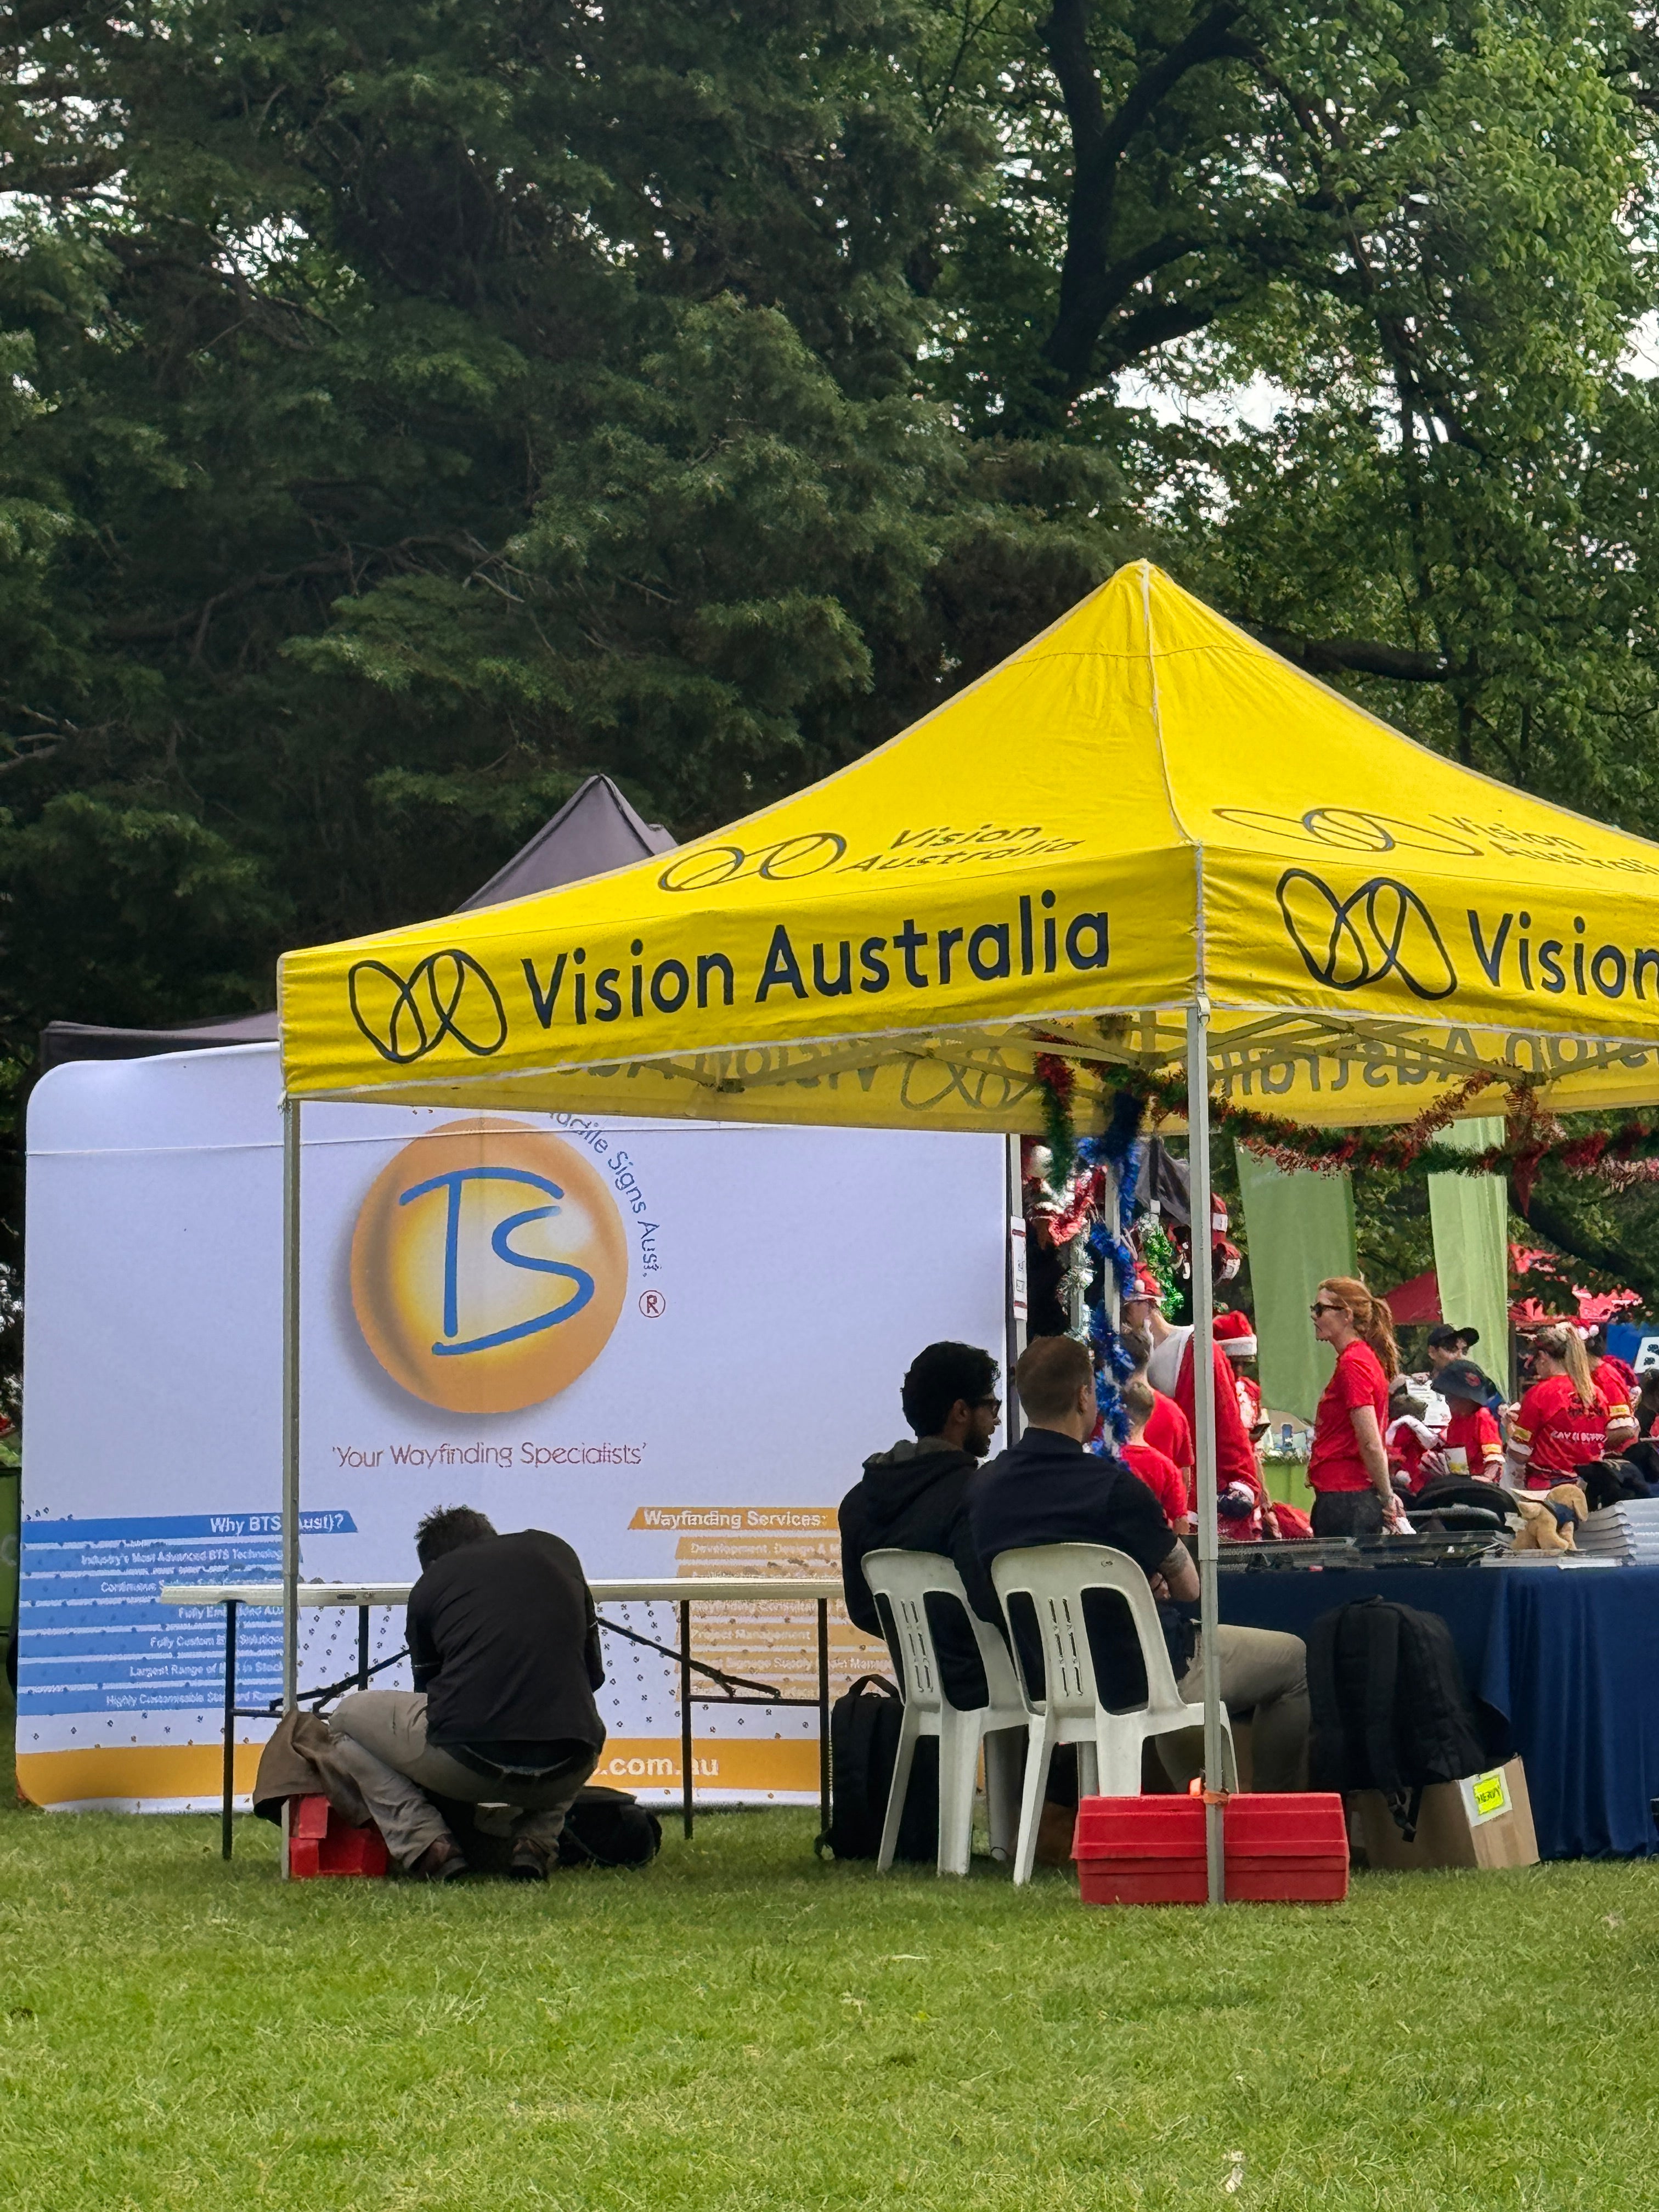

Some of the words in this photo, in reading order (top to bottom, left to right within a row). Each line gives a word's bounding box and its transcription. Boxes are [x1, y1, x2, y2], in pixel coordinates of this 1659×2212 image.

[888, 823, 1042, 849] Vision
[1428, 814, 1588, 850] Vision
[833, 838, 1086, 874] Australia
[1488, 840, 1659, 875] Australi
[521, 939, 734, 1029] Vision
[754, 889, 1109, 1003] Australia
[1467, 910, 1659, 1000] Vision
[608, 1151, 647, 1214] Signs
[390, 1442, 513, 1470] Wayfinding
[210, 1517, 245, 1536] Why
[249, 1515, 281, 1532] BTS
[644, 1508, 742, 1529] Wayfinding
[208, 1548, 229, 1560] BTS
[232, 1548, 283, 1561] Technolog
